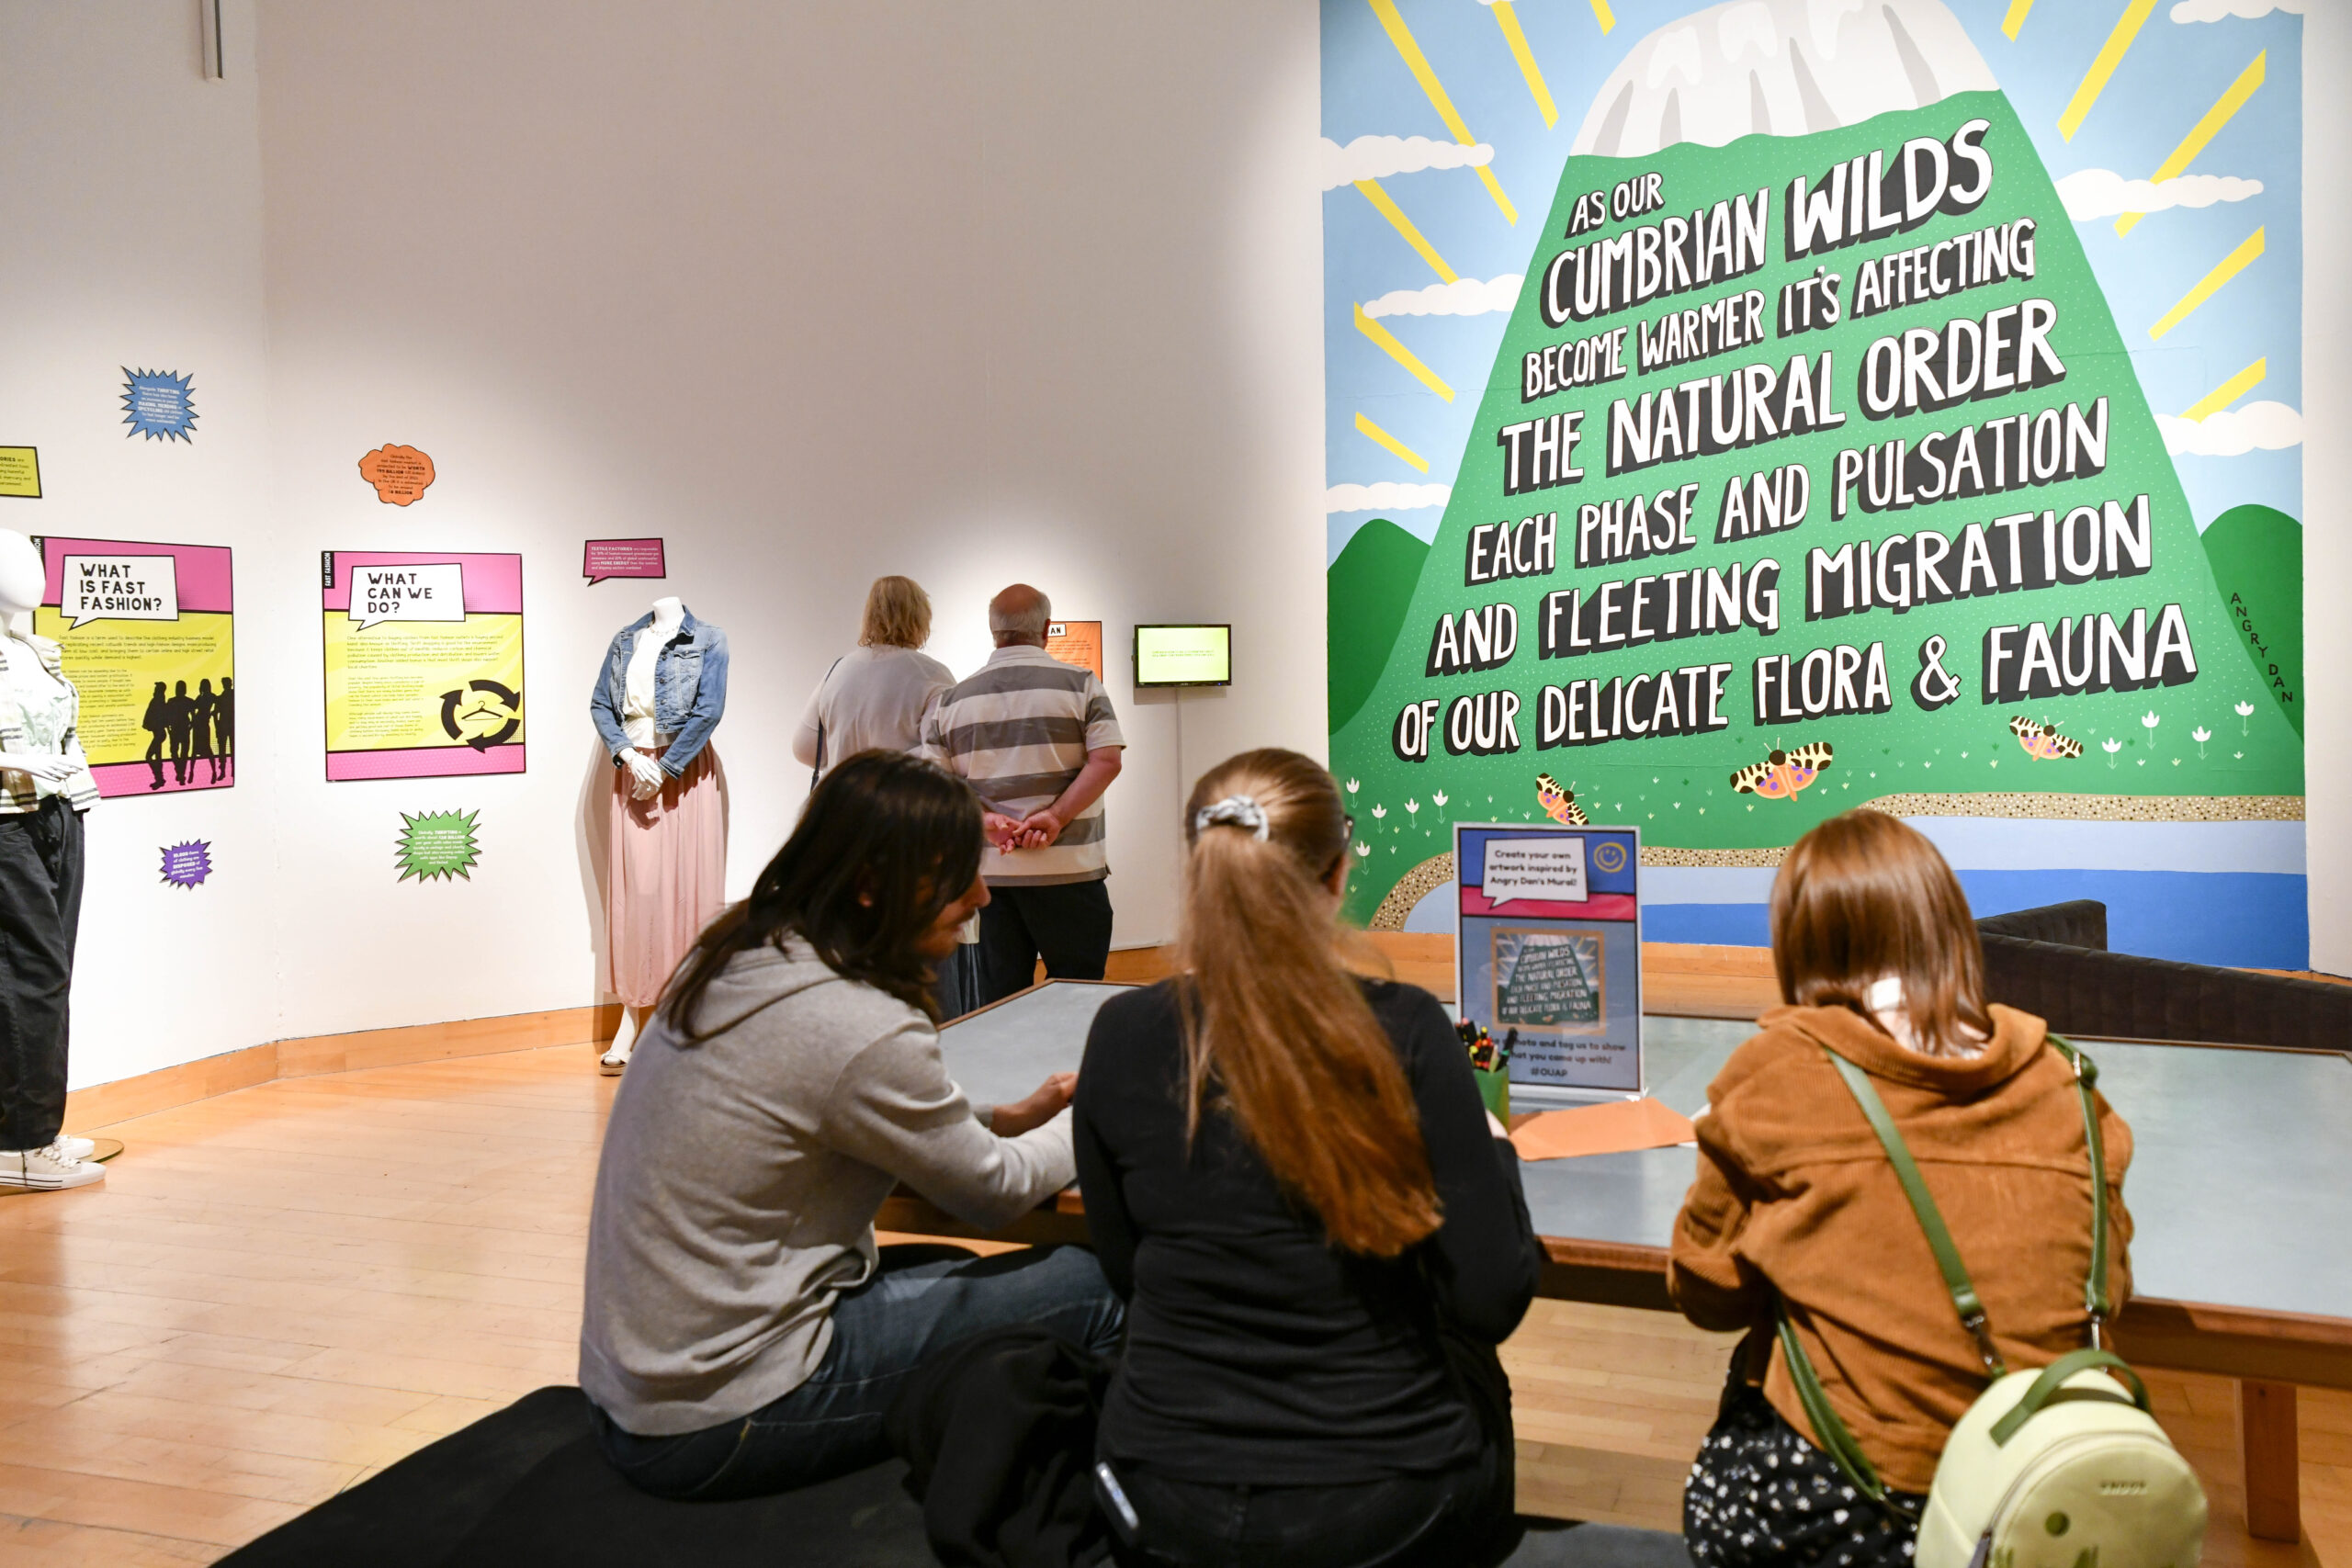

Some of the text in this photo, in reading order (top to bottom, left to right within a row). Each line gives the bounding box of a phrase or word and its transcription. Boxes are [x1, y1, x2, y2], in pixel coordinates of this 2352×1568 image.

[1567, 172, 1665, 237] AS OUR
[1544, 118, 1994, 327] CUMBRIAN WILDS
[1522, 217, 2036, 401] BECOME WARMER IT'S AFFECTING
[1498, 298, 2067, 492] THE NATURAL ORDER
[1467, 396, 2109, 584] EACH PHASE AND PULSATION
[80, 562, 131, 579] WHAT
[368, 572, 417, 585] WHAT
[80, 579, 145, 595] IS FAST
[1430, 493, 2152, 672] AND FLEETING MIGRATION
[368, 587, 433, 600] CAN WE
[80, 596, 162, 611] FASHION?
[368, 601, 400, 614] DO?
[2231, 592, 2293, 703] ANGRY DAN
[1396, 604, 2198, 760] OF OUR DELICATE FLORA & FAUNA
[1494, 850, 1525, 859] Create
[1528, 852, 1549, 861] your
[1489, 863, 1577, 875] artwork inspired by
[1490, 876, 1519, 886] Angry
[1521, 876, 1544, 885] Dan's
[1514, 1038, 1537, 1047] hoto
[1539, 1040, 1556, 1048] and
[1558, 1041, 1574, 1051] tag
[1601, 1043, 1626, 1052] show
[1510, 1051, 1526, 1059] hat
[1529, 1054, 1546, 1062] you
[1575, 1056, 1587, 1065] up
